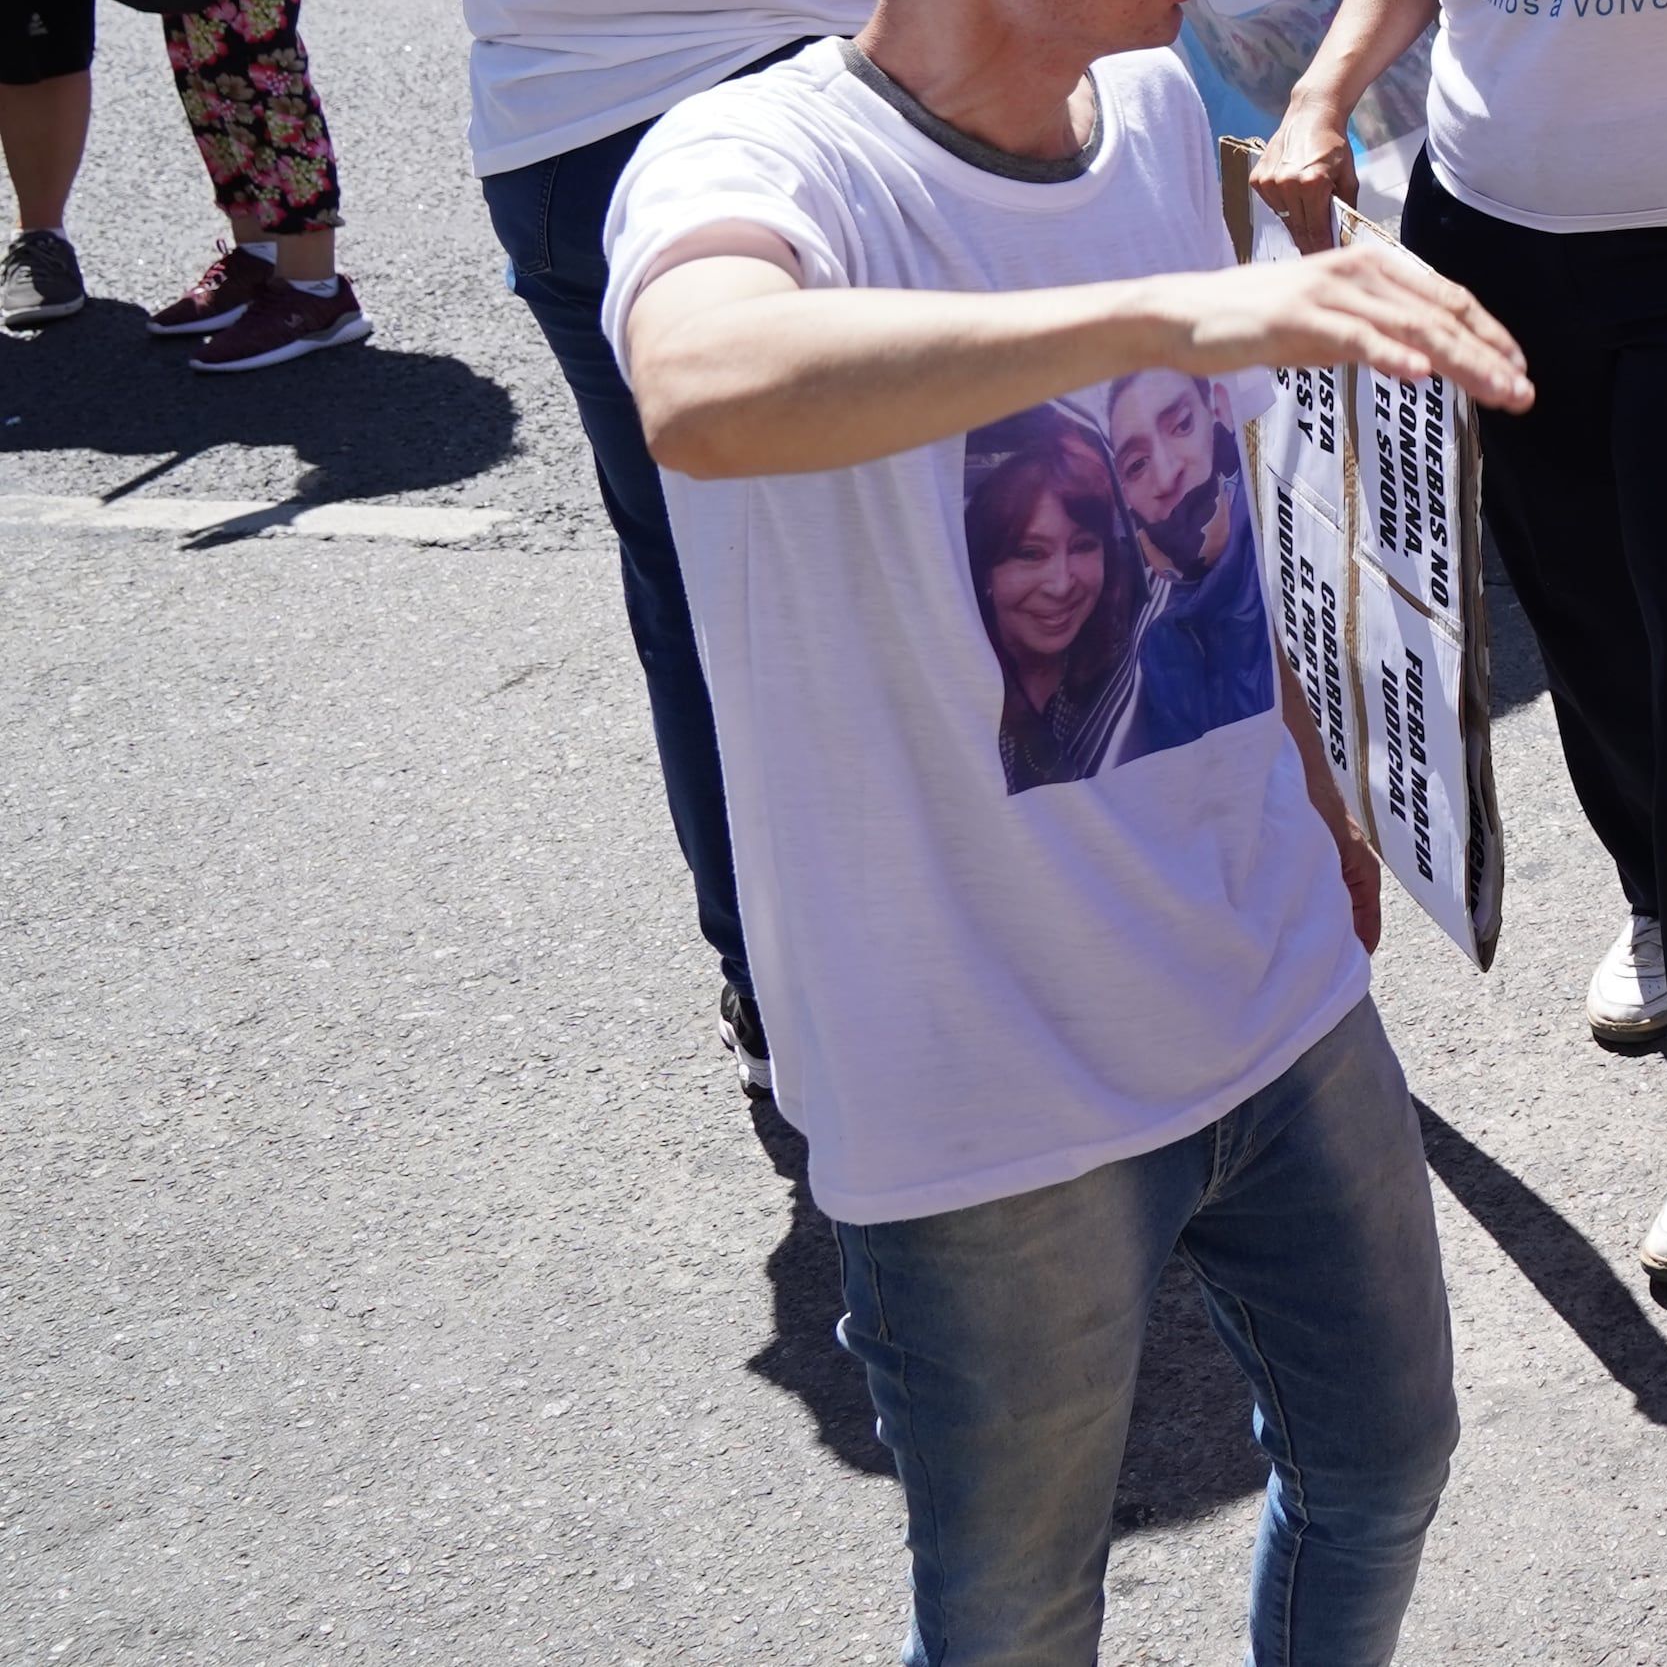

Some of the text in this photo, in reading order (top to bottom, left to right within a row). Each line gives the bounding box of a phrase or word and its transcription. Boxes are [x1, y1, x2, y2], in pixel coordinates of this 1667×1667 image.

[1298, 418, 1313, 444] Y
[1375, 382, 1391, 422] EL
[1399, 379, 1423, 558] CONDENA,
[1277, 485, 1299, 649] JUDICIAL
[1376, 429, 1398, 553] SHOW.
[1424, 372, 1449, 608] PRUEBAS NO
[1300, 554, 1322, 729] EL PARTID
[1321, 581, 1346, 771] COBARDES
[1381, 660, 1406, 822] JUDICIAL
[1405, 647, 1434, 883] FUERA MAFIA
